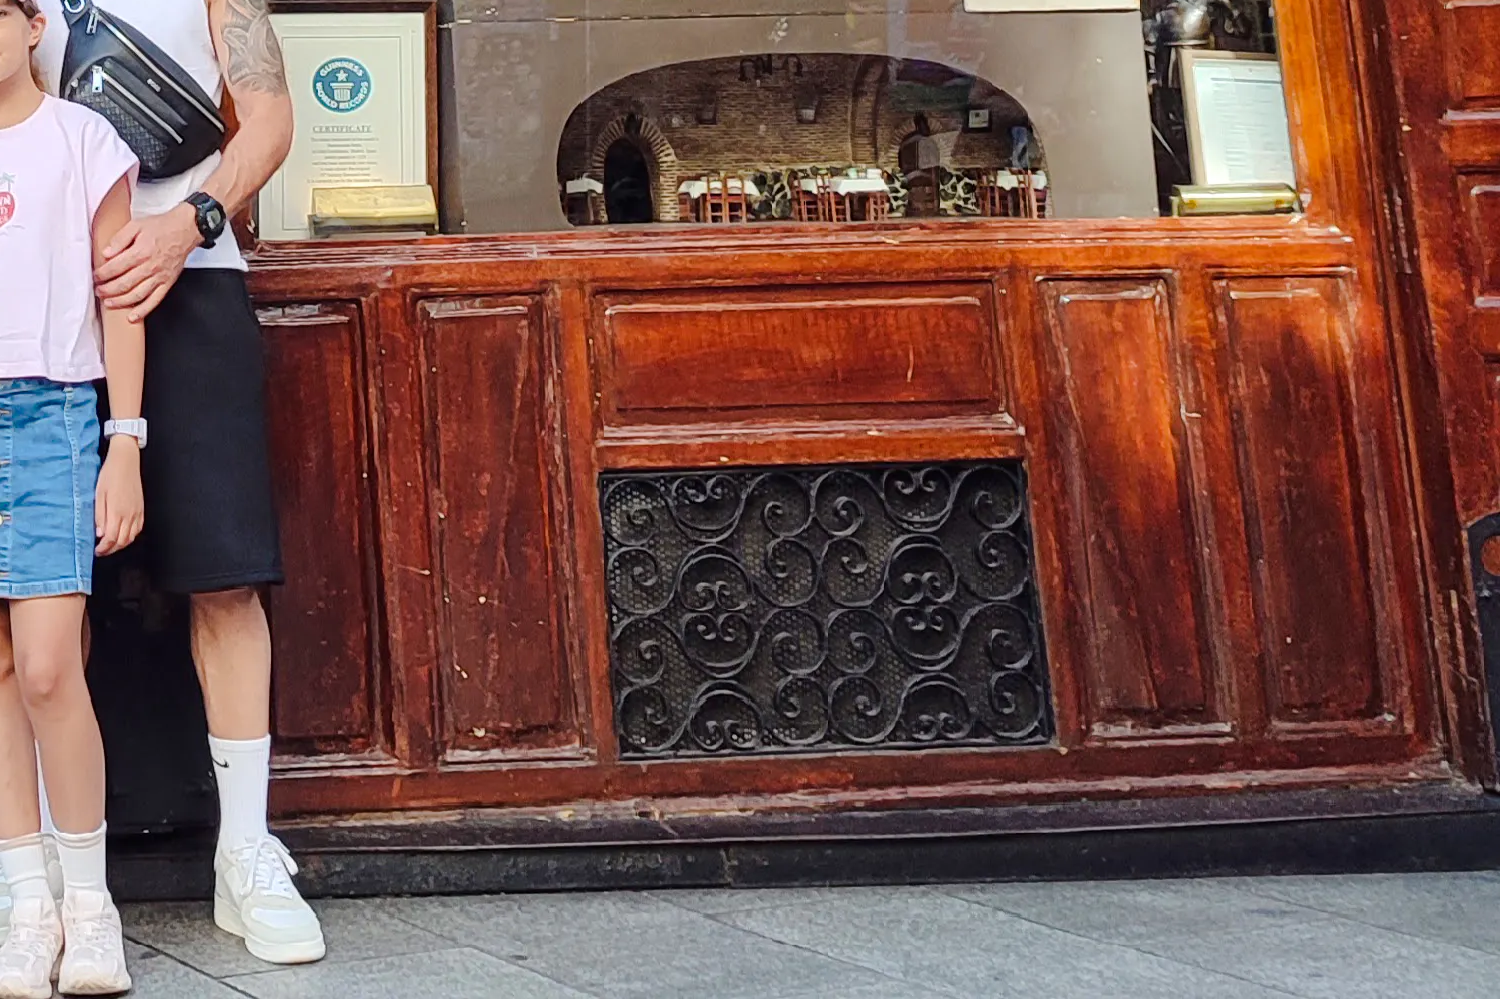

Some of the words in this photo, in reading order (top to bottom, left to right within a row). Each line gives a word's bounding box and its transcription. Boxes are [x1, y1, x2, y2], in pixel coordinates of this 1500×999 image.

[319, 60, 364, 77] GUINNESS
[315, 81, 338, 109] WORLD
[338, 81, 369, 109] RECORDS
[312, 125, 373, 133] CERTIFICATE
